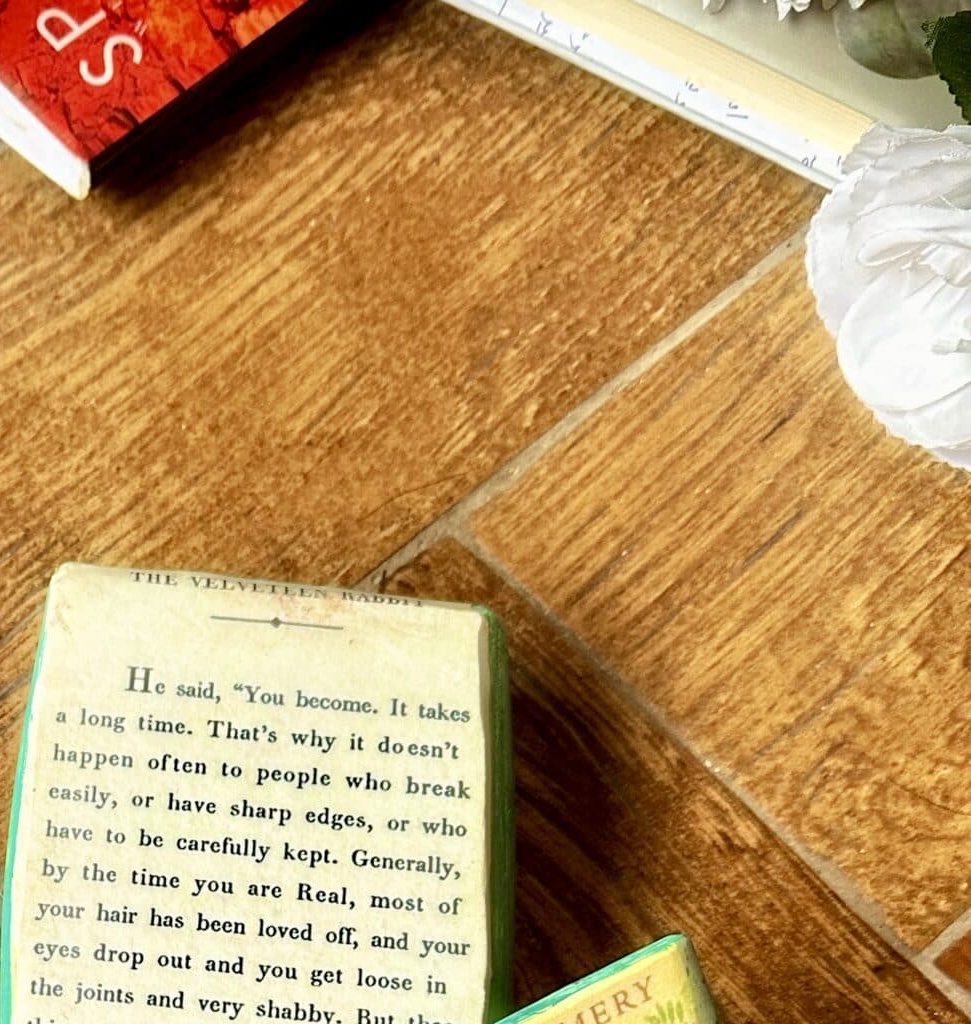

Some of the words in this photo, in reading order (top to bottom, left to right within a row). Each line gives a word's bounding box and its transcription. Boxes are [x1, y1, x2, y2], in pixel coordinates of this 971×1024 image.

[129, 572, 179, 586] THE
[124, 666, 166, 696] He
[176, 681, 222, 704] said,
[232, 683, 286, 707] "You
[295, 691, 379, 715] become.
[389, 699, 408, 717] It
[417, 702, 471, 723] takes
[55, 710, 67, 723] a
[79, 708, 126, 734] long
[138, 714, 194, 735] time.
[206, 719, 279, 744] That's
[291, 730, 338, 752] why
[349, 733, 365, 751] it
[377, 737, 460, 760] doesn't
[52, 743, 134, 770] happen
[146, 753, 208, 776] often
[221, 761, 243, 778] to
[256, 765, 332, 787] people
[345, 773, 393, 792] who
[405, 775, 472, 800] break
[48, 784, 119, 809] easily,
[130, 793, 155, 809] or
[166, 793, 217, 815] have
[229, 800, 293, 826] sharp
[305, 807, 375, 833] edges,
[386, 817, 411, 832] or
[421, 818, 468, 838] who
[44, 820, 94, 842] have
[105, 826, 126, 845] to
[138, 828, 165, 849] be
[175, 833, 271, 863] carefully
[283, 842, 339, 868] kept.
[350, 849, 463, 880] Generally,
[40, 860, 71, 882] by
[81, 863, 119, 883] the
[130, 867, 181, 890] time
[191, 879, 234, 897] you
[247, 882, 283, 899] are
[296, 882, 357, 910] Real,
[369, 893, 425, 912] most
[437, 897, 464, 916] of
[34, 902, 86, 921] your
[95, 905, 138, 925] hair
[149, 908, 185, 930] has
[196, 914, 246, 937] been
[257, 919, 313, 942] loved
[324, 926, 360, 949] off,
[369, 931, 410, 951] and
[419, 937, 472, 958] your
[33, 942, 81, 961] eyes
[93, 944, 146, 970] drop
[156, 951, 193, 970] out
[204, 954, 246, 976] and
[255, 963, 298, 982] you
[309, 967, 344, 986] get
[356, 968, 414, 991] loose
[425, 976, 448, 995] in
[29, 978, 64, 999] the
[74, 981, 135, 1005] joints
[146, 989, 185, 1010] and
[197, 998, 246, 1020] very
